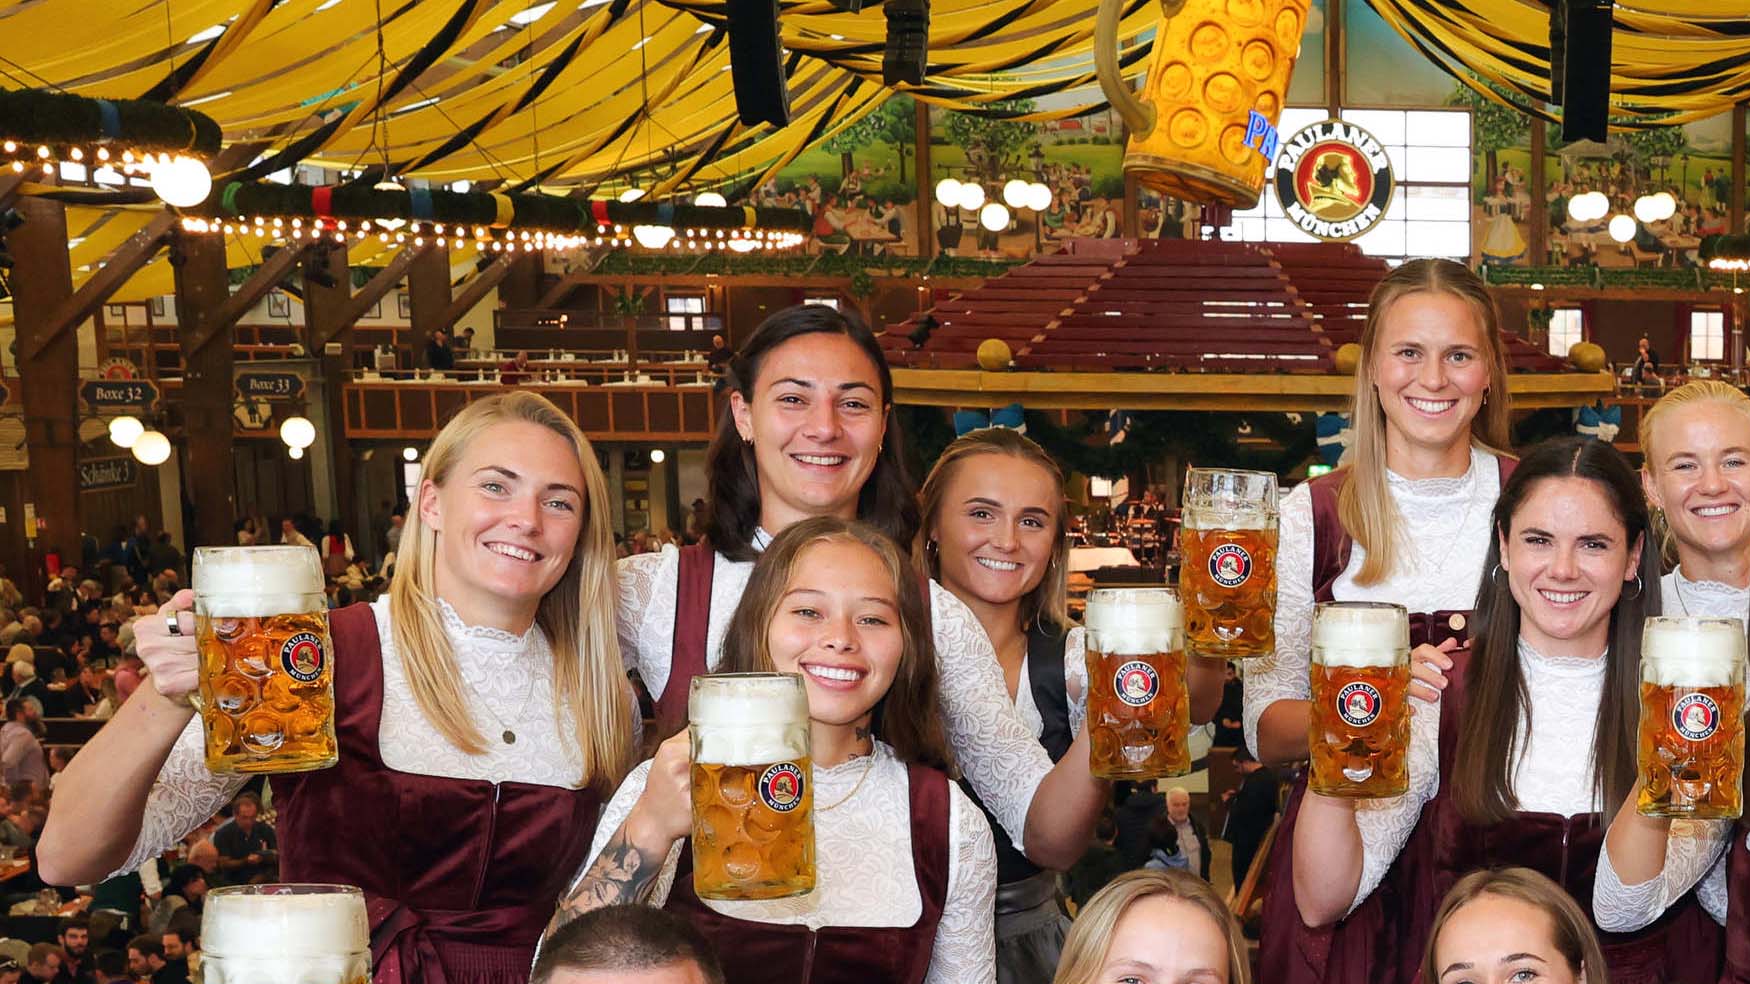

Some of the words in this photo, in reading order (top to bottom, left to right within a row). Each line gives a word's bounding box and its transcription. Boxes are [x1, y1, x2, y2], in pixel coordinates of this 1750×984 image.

[1282, 122, 1388, 174] PAULANER
[1286, 201, 1382, 239] MÜNCHEN
[250, 379, 275, 390] Boxe
[96, 387, 125, 400] Boxe
[125, 387, 143, 402] 32
[1212, 546, 1249, 561] PAULANER
[283, 634, 322, 654] PAULANER
[1118, 663, 1156, 680] PAULANER
[1341, 684, 1379, 701] PAULANER
[1677, 695, 1716, 712] PAULANER
[762, 765, 801, 784] PAULANER
